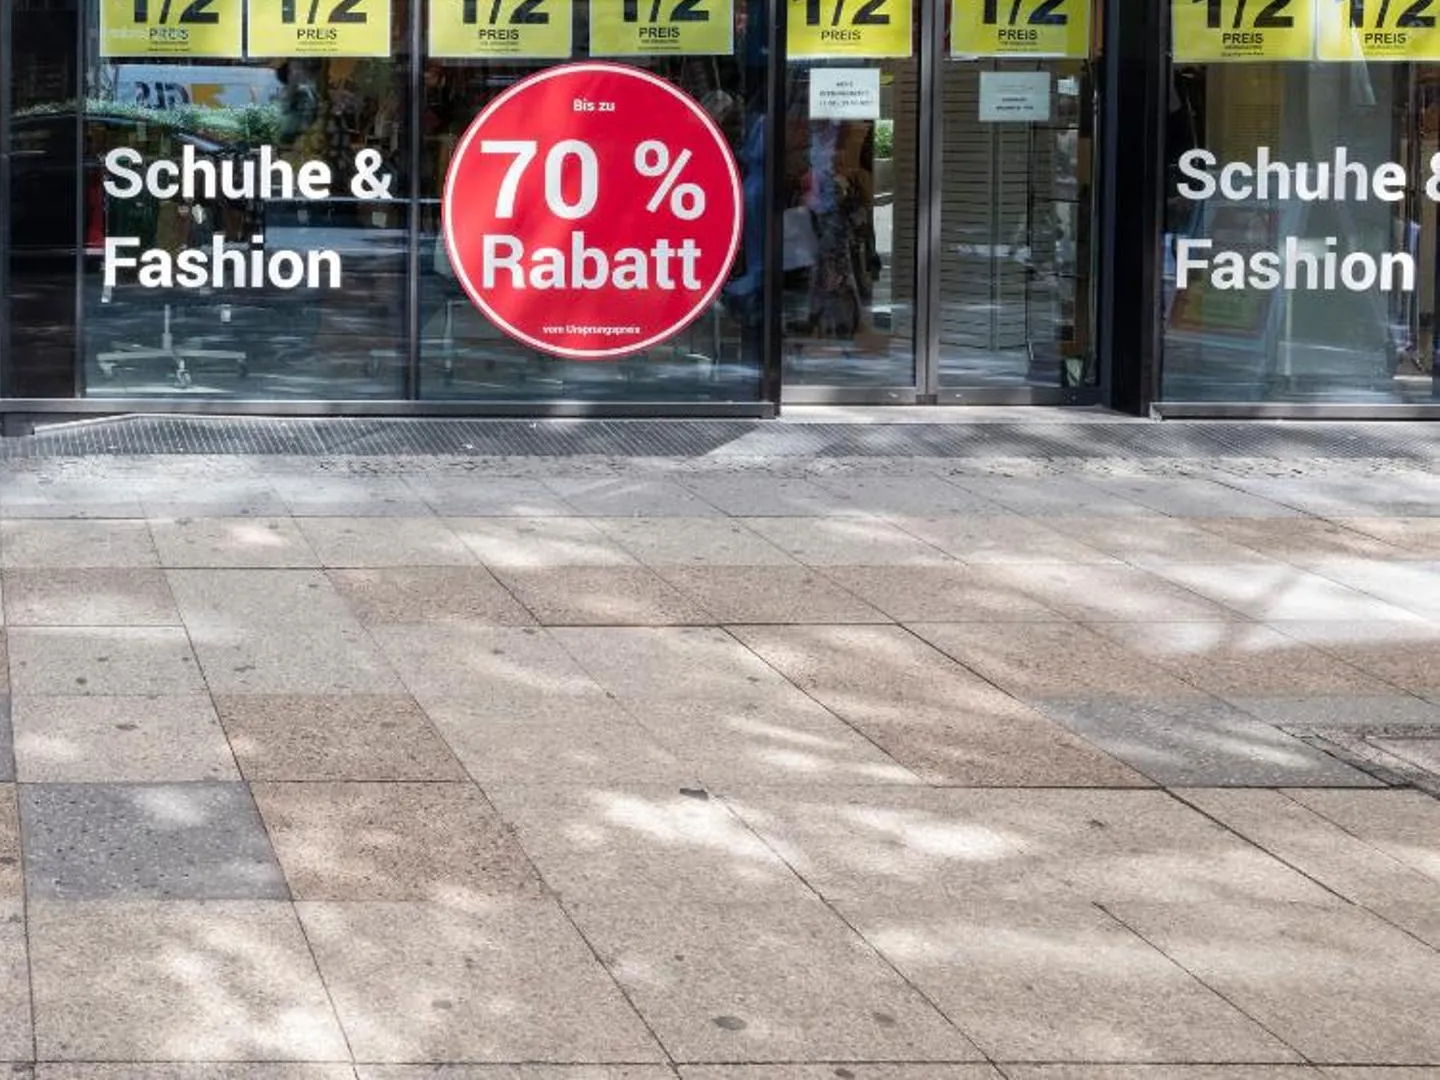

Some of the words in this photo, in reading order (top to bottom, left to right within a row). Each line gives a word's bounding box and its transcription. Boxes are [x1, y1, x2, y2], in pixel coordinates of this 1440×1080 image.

[297, 29, 338, 40] PREIS
[479, 29, 520, 40] PREIS
[639, 27, 680, 38] PREIS
[821, 30, 861, 41] PREIS
[998, 30, 1038, 40] PREIS
[1365, 33, 1407, 44] PREIS
[1222, 33, 1264, 45] PREIS
[573, 99, 594, 112] Bis
[598, 101, 615, 112] zu
[103, 145, 331, 199] Schuhe
[350, 148, 393, 199] &
[1176, 146, 1406, 201] Schuhe
[480, 139, 599, 220] 70
[634, 140, 706, 221] %
[103, 234, 342, 288] Fashion
[482, 231, 702, 290] Rabatt
[1176, 236, 1416, 291] Fashion
[543, 325, 564, 334] vom
